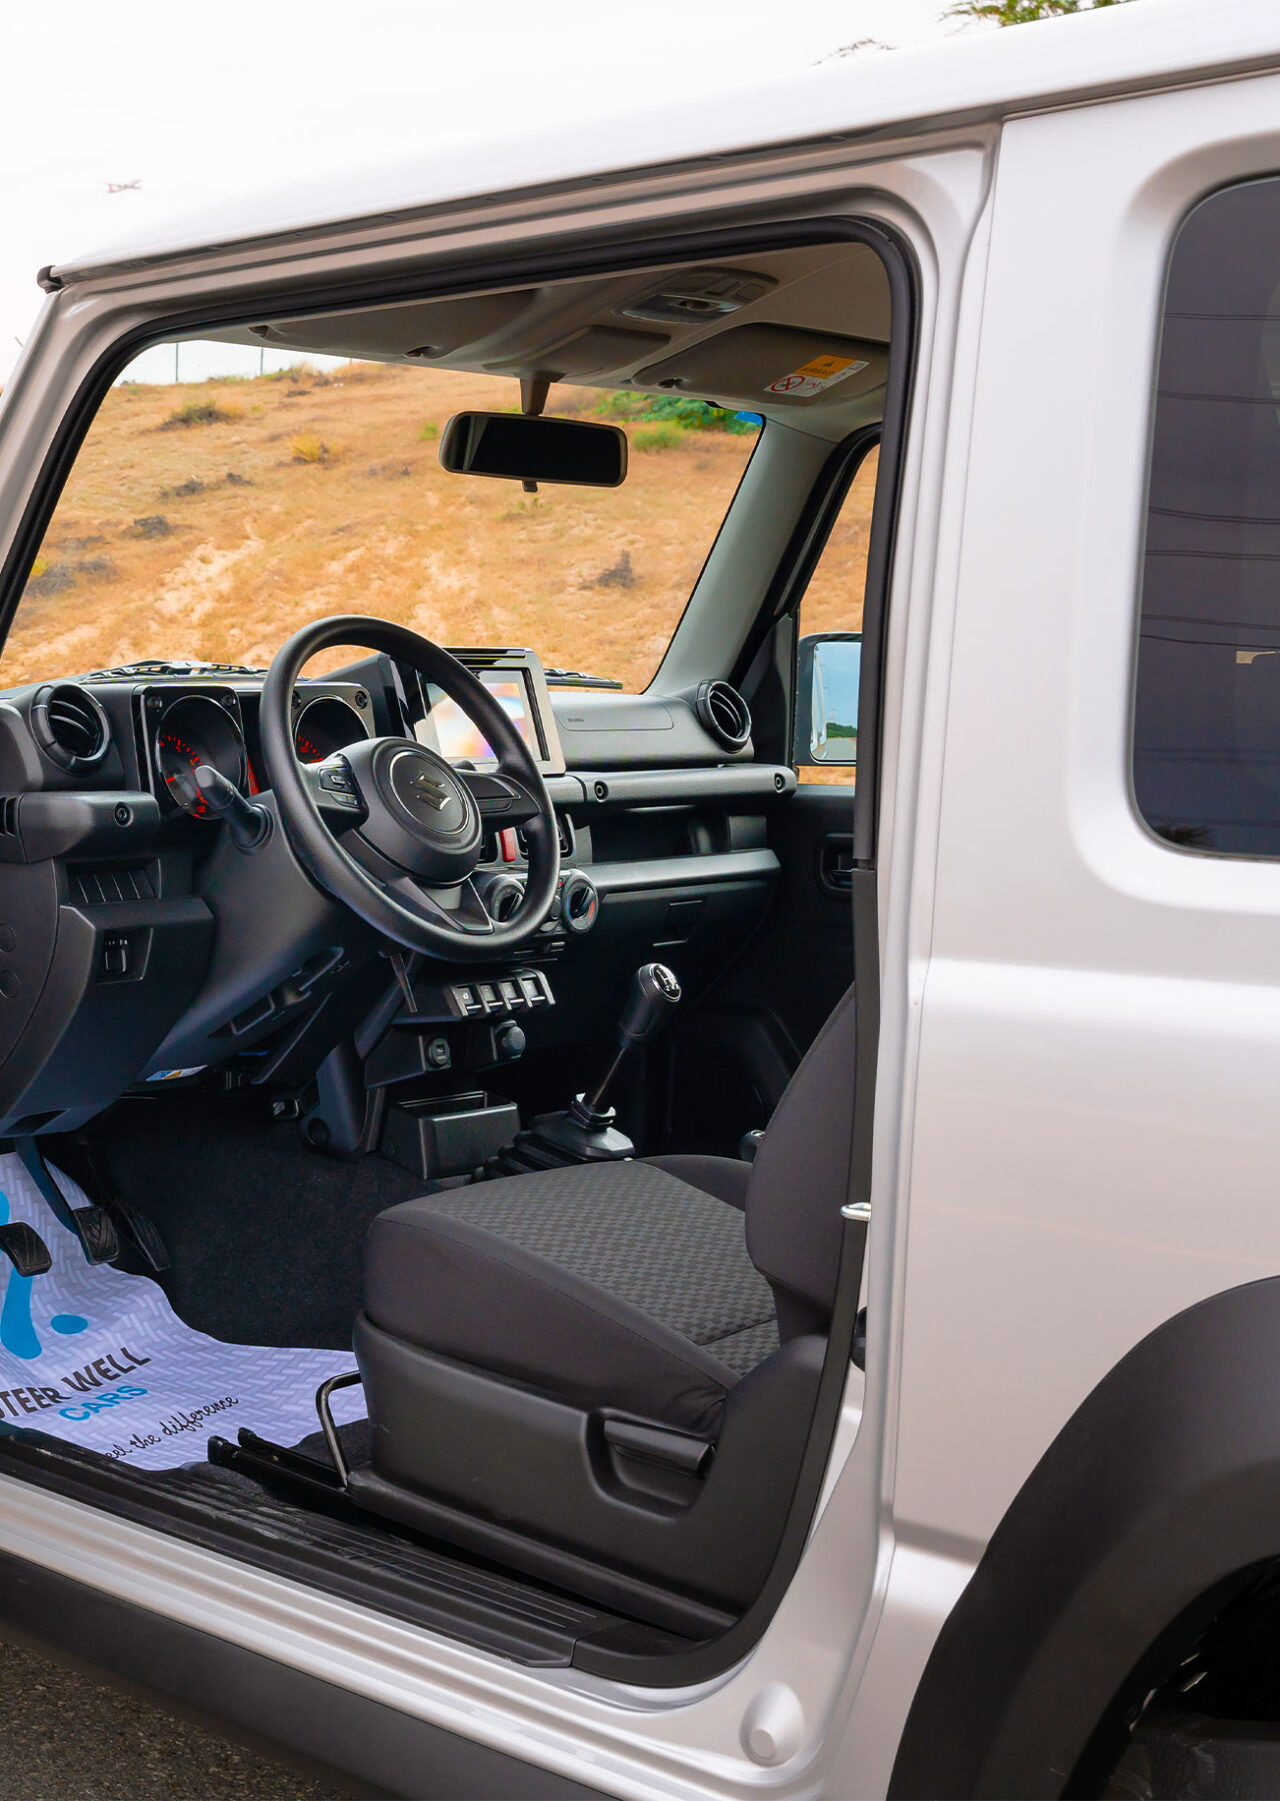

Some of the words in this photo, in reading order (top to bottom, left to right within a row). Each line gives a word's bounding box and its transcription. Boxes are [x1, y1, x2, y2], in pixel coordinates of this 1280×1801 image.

[61, 1347, 152, 1392] WELL
[58, 1385, 148, 1421] CARS
[104, 1444, 133, 1459] eel
[130, 1433, 162, 1449] the
[159, 1396, 239, 1432] difference
